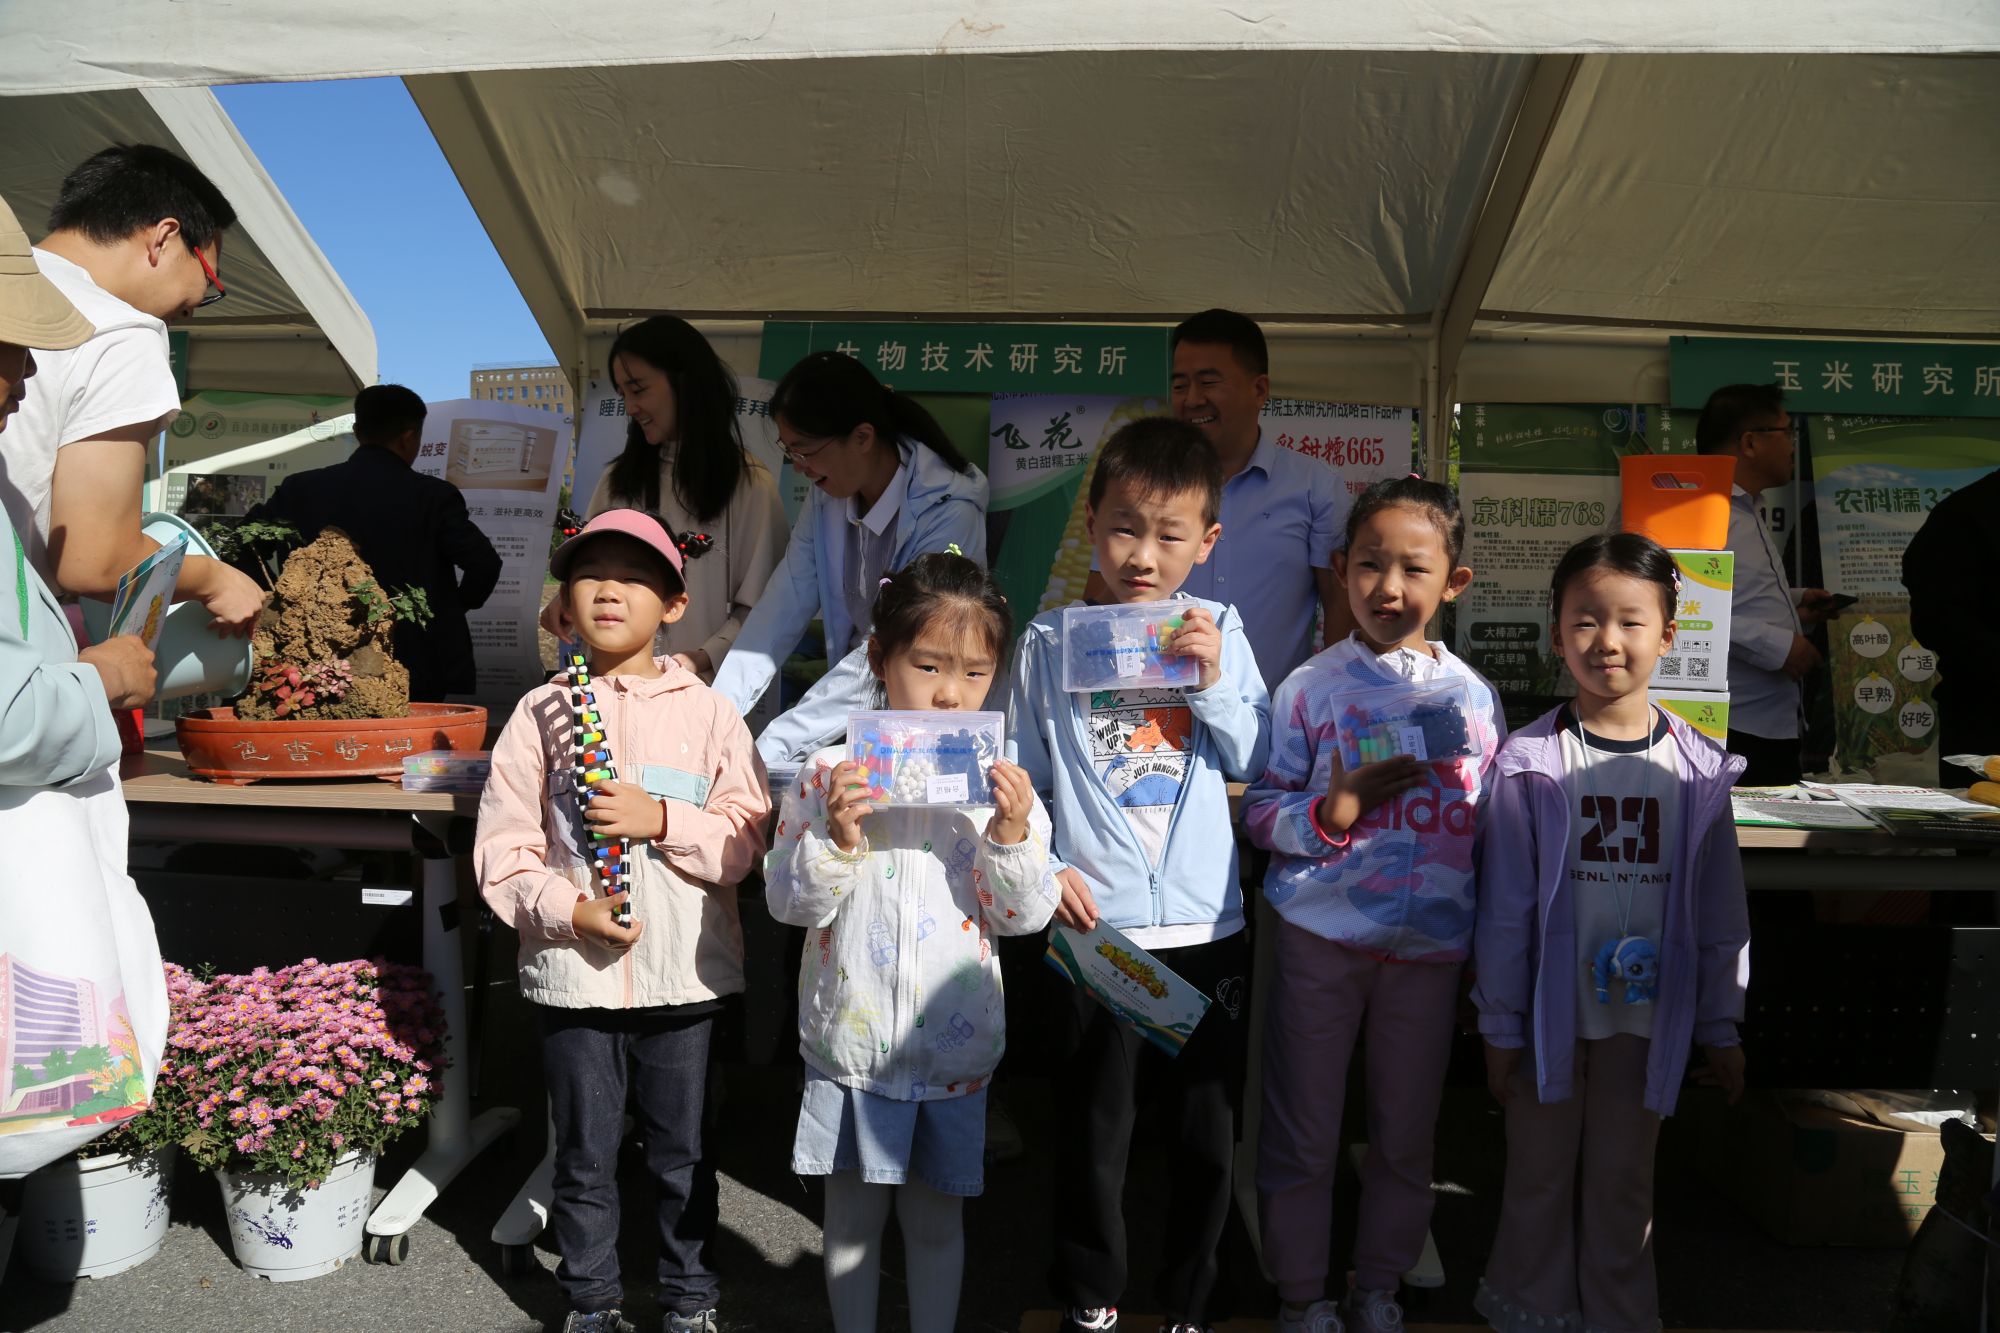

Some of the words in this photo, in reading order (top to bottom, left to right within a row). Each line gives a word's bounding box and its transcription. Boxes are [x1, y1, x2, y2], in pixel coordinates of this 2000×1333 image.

[834, 341, 1129, 376] 生物技术研究所
[1772, 360, 2000, 397] 玉米研究所
[991, 411, 1083, 450] 飞花
[1016, 453, 1089, 471] 黄白甜糯玉米
[1472, 497, 1605, 528] 京科糯768
[1484, 626, 1529, 639] 大棒高产
[1852, 634, 1889, 646] 高叶酸
[1483, 653, 1527, 665] 广适早熟
[1901, 655, 1934, 671] 广适
[1858, 687, 1893, 703] 早熟
[1901, 711, 1932, 728] 好吃
[1096, 719, 1120, 742] WHAT
[1106, 734, 1122, 750] UP!
[1134, 763, 1150, 780] JUST
[1580, 796, 1660, 864] 23
